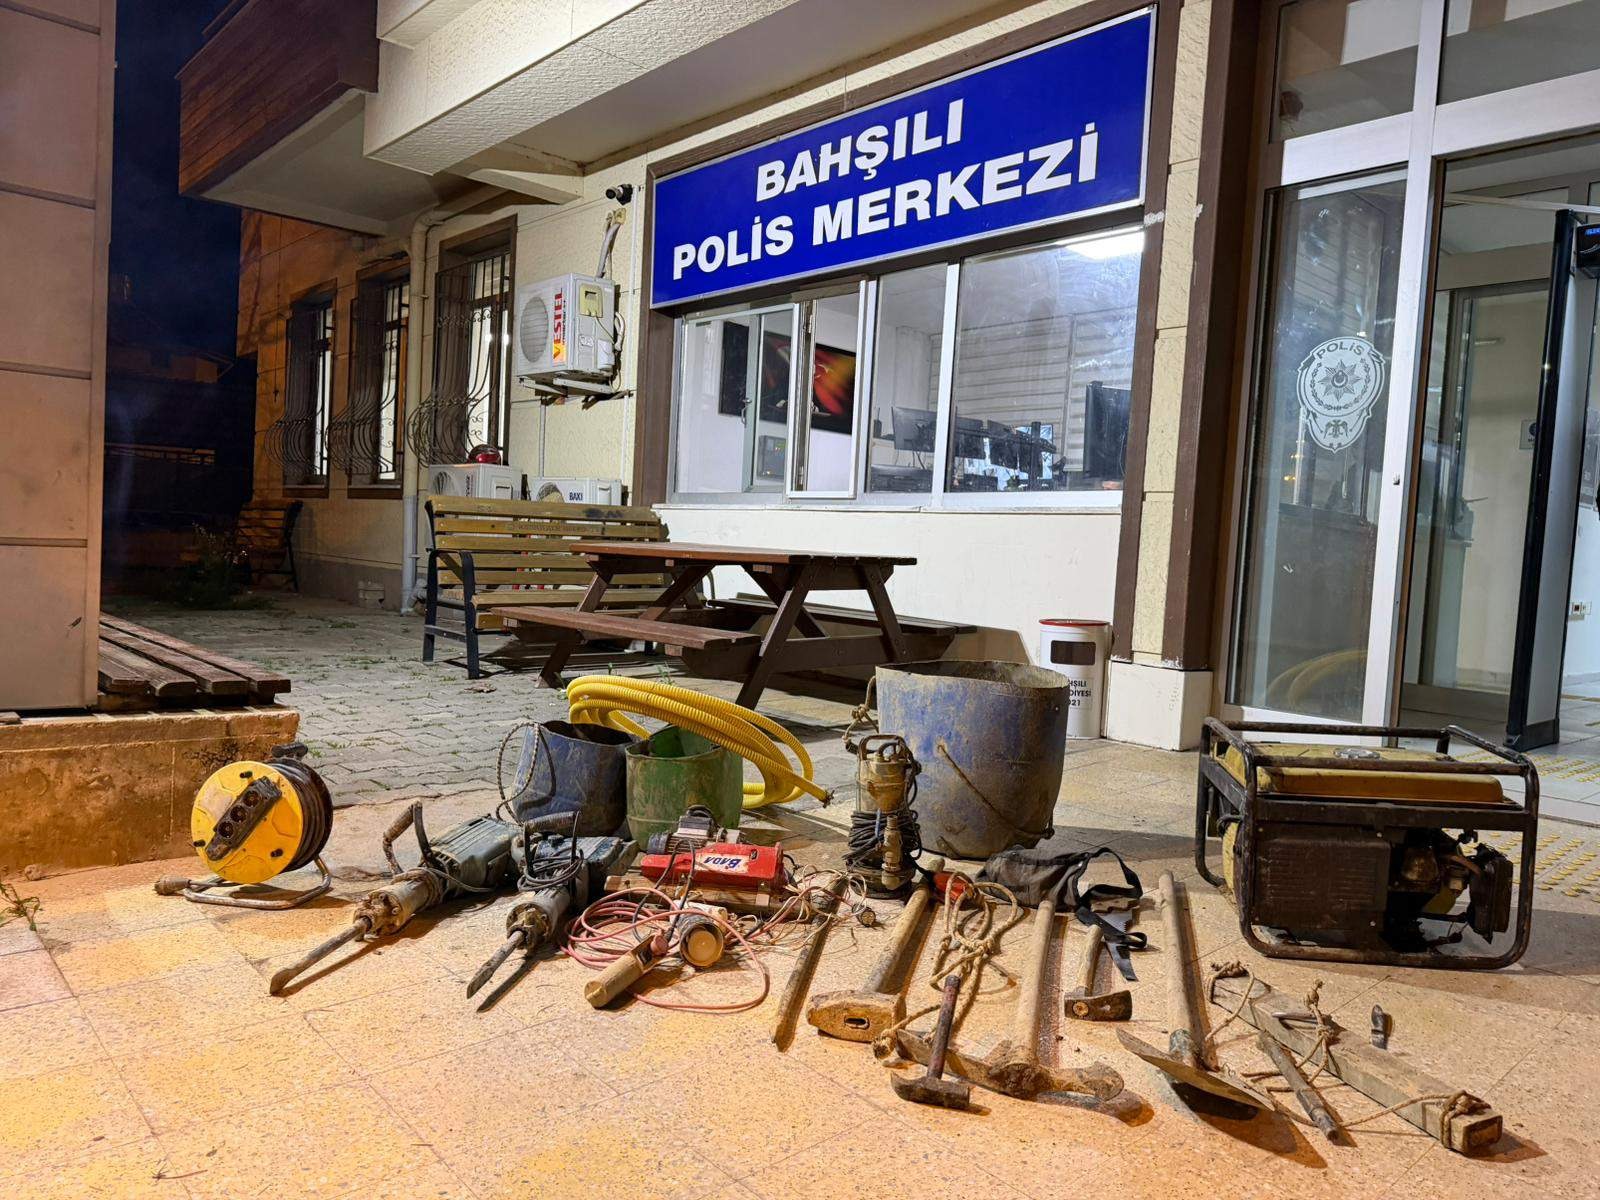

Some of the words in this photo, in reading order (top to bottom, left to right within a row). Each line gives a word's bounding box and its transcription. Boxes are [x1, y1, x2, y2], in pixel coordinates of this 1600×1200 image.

[756, 99, 964, 202] BAHŞILI
[672, 215, 794, 281] POLİS
[812, 122, 1099, 245] MERKEZİ
[553, 288, 563, 359] VESTEL
[1316, 341, 1365, 359] POLİS
[569, 492, 583, 501] BAXI
